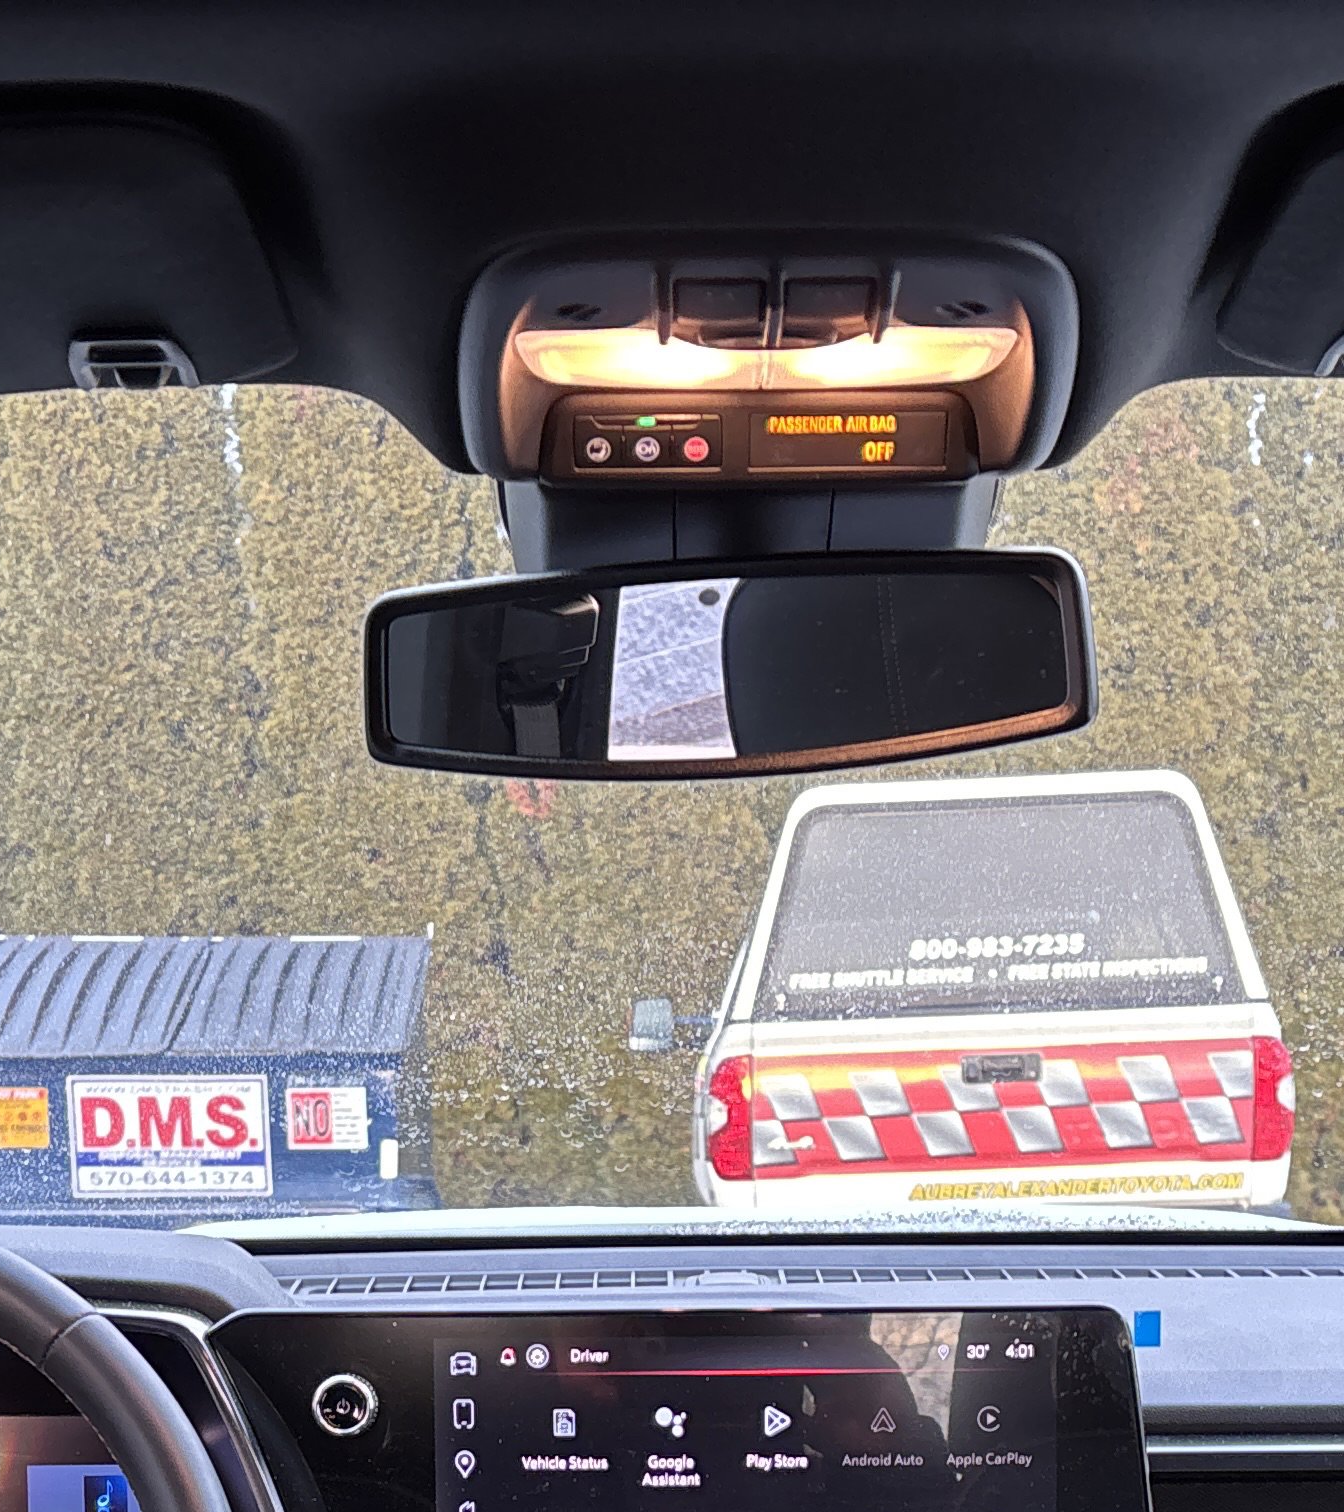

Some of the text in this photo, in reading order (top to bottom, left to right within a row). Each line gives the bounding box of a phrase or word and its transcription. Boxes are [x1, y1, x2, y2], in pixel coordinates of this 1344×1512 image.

[767, 414, 897, 434] PASSENGER AIR BAG
[862, 440, 895, 462] OFF
[80, 1095, 258, 1148] D.M.S.
[570, 1348, 609, 1363] Driver
[1005, 1343, 1035, 1359] 4:01
[521, 1455, 609, 1471] Vehicle Status
[647, 1454, 695, 1473] Google
[745, 1453, 809, 1471] Play Store
[842, 1452, 924, 1467] Android Auto
[946, 1451, 1033, 1469] Apple CarPlay
[641, 1471, 701, 1487] Assistant
